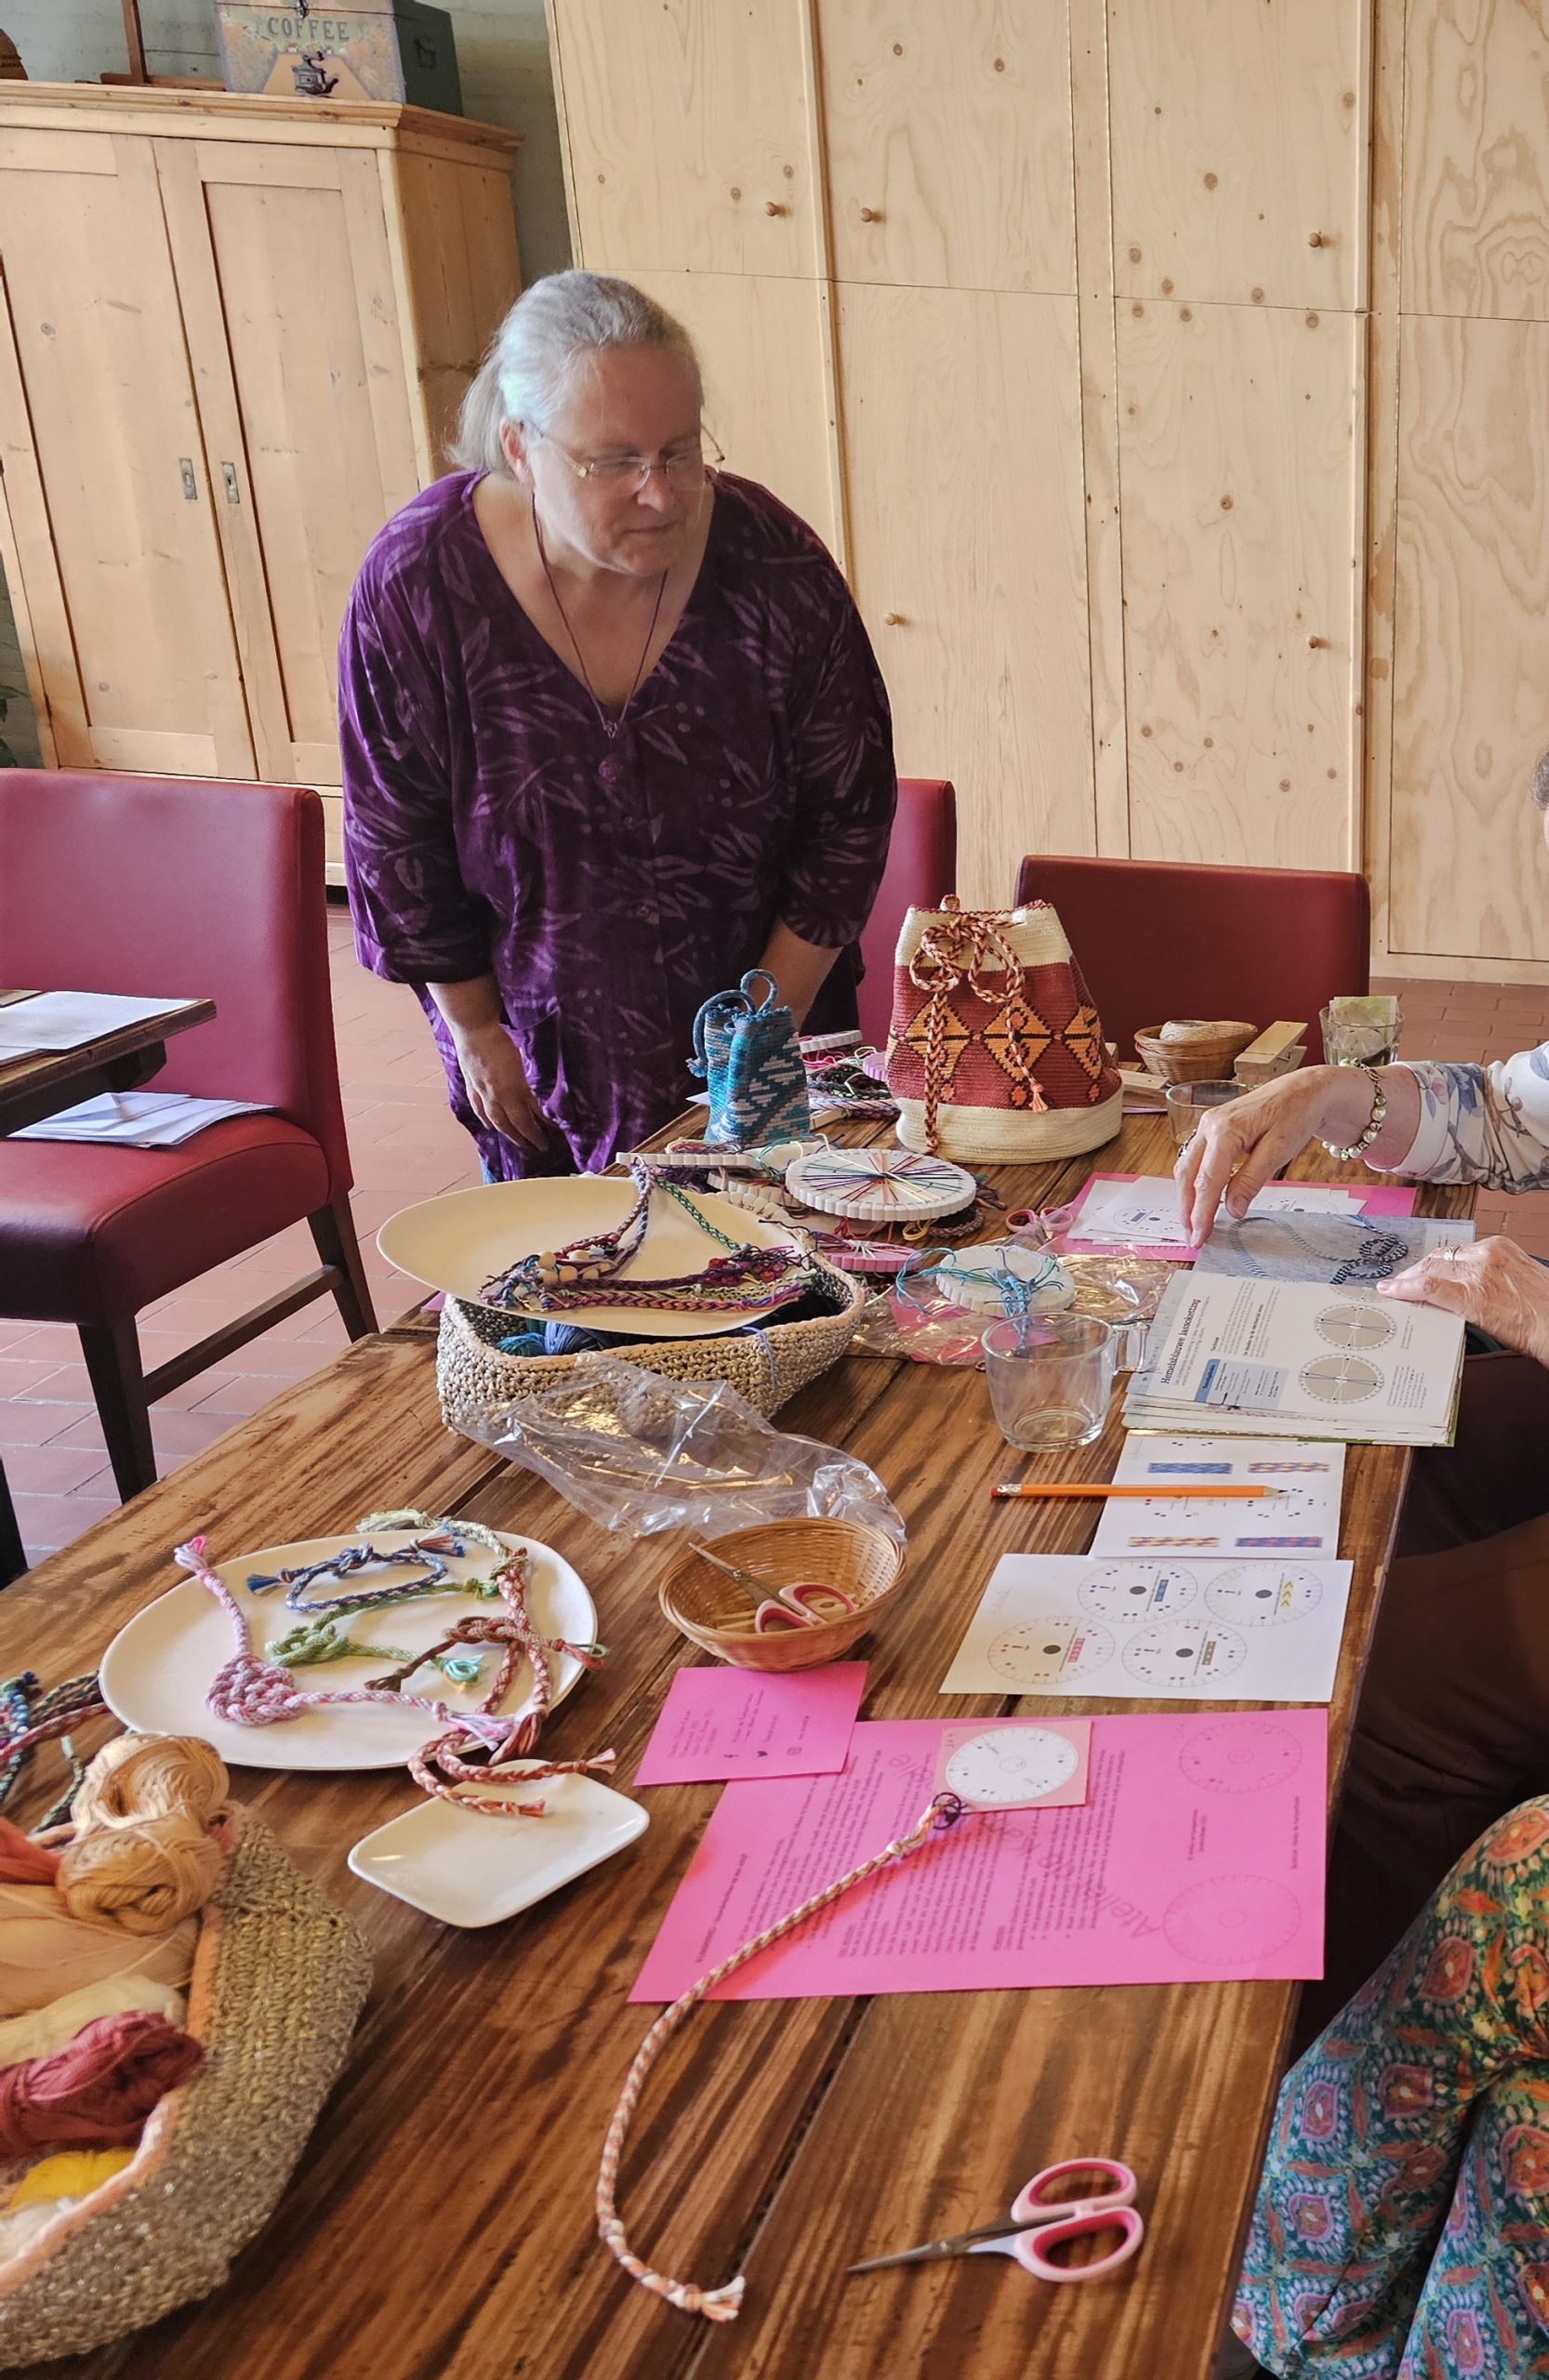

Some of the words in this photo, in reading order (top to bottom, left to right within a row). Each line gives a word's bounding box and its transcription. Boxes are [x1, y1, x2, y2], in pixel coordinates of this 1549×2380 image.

[267, 17, 351, 41] COFFEE
[1160, 1337, 1185, 1384] Hemelsblauwe
[1178, 1298, 1201, 1337] lassoketting
